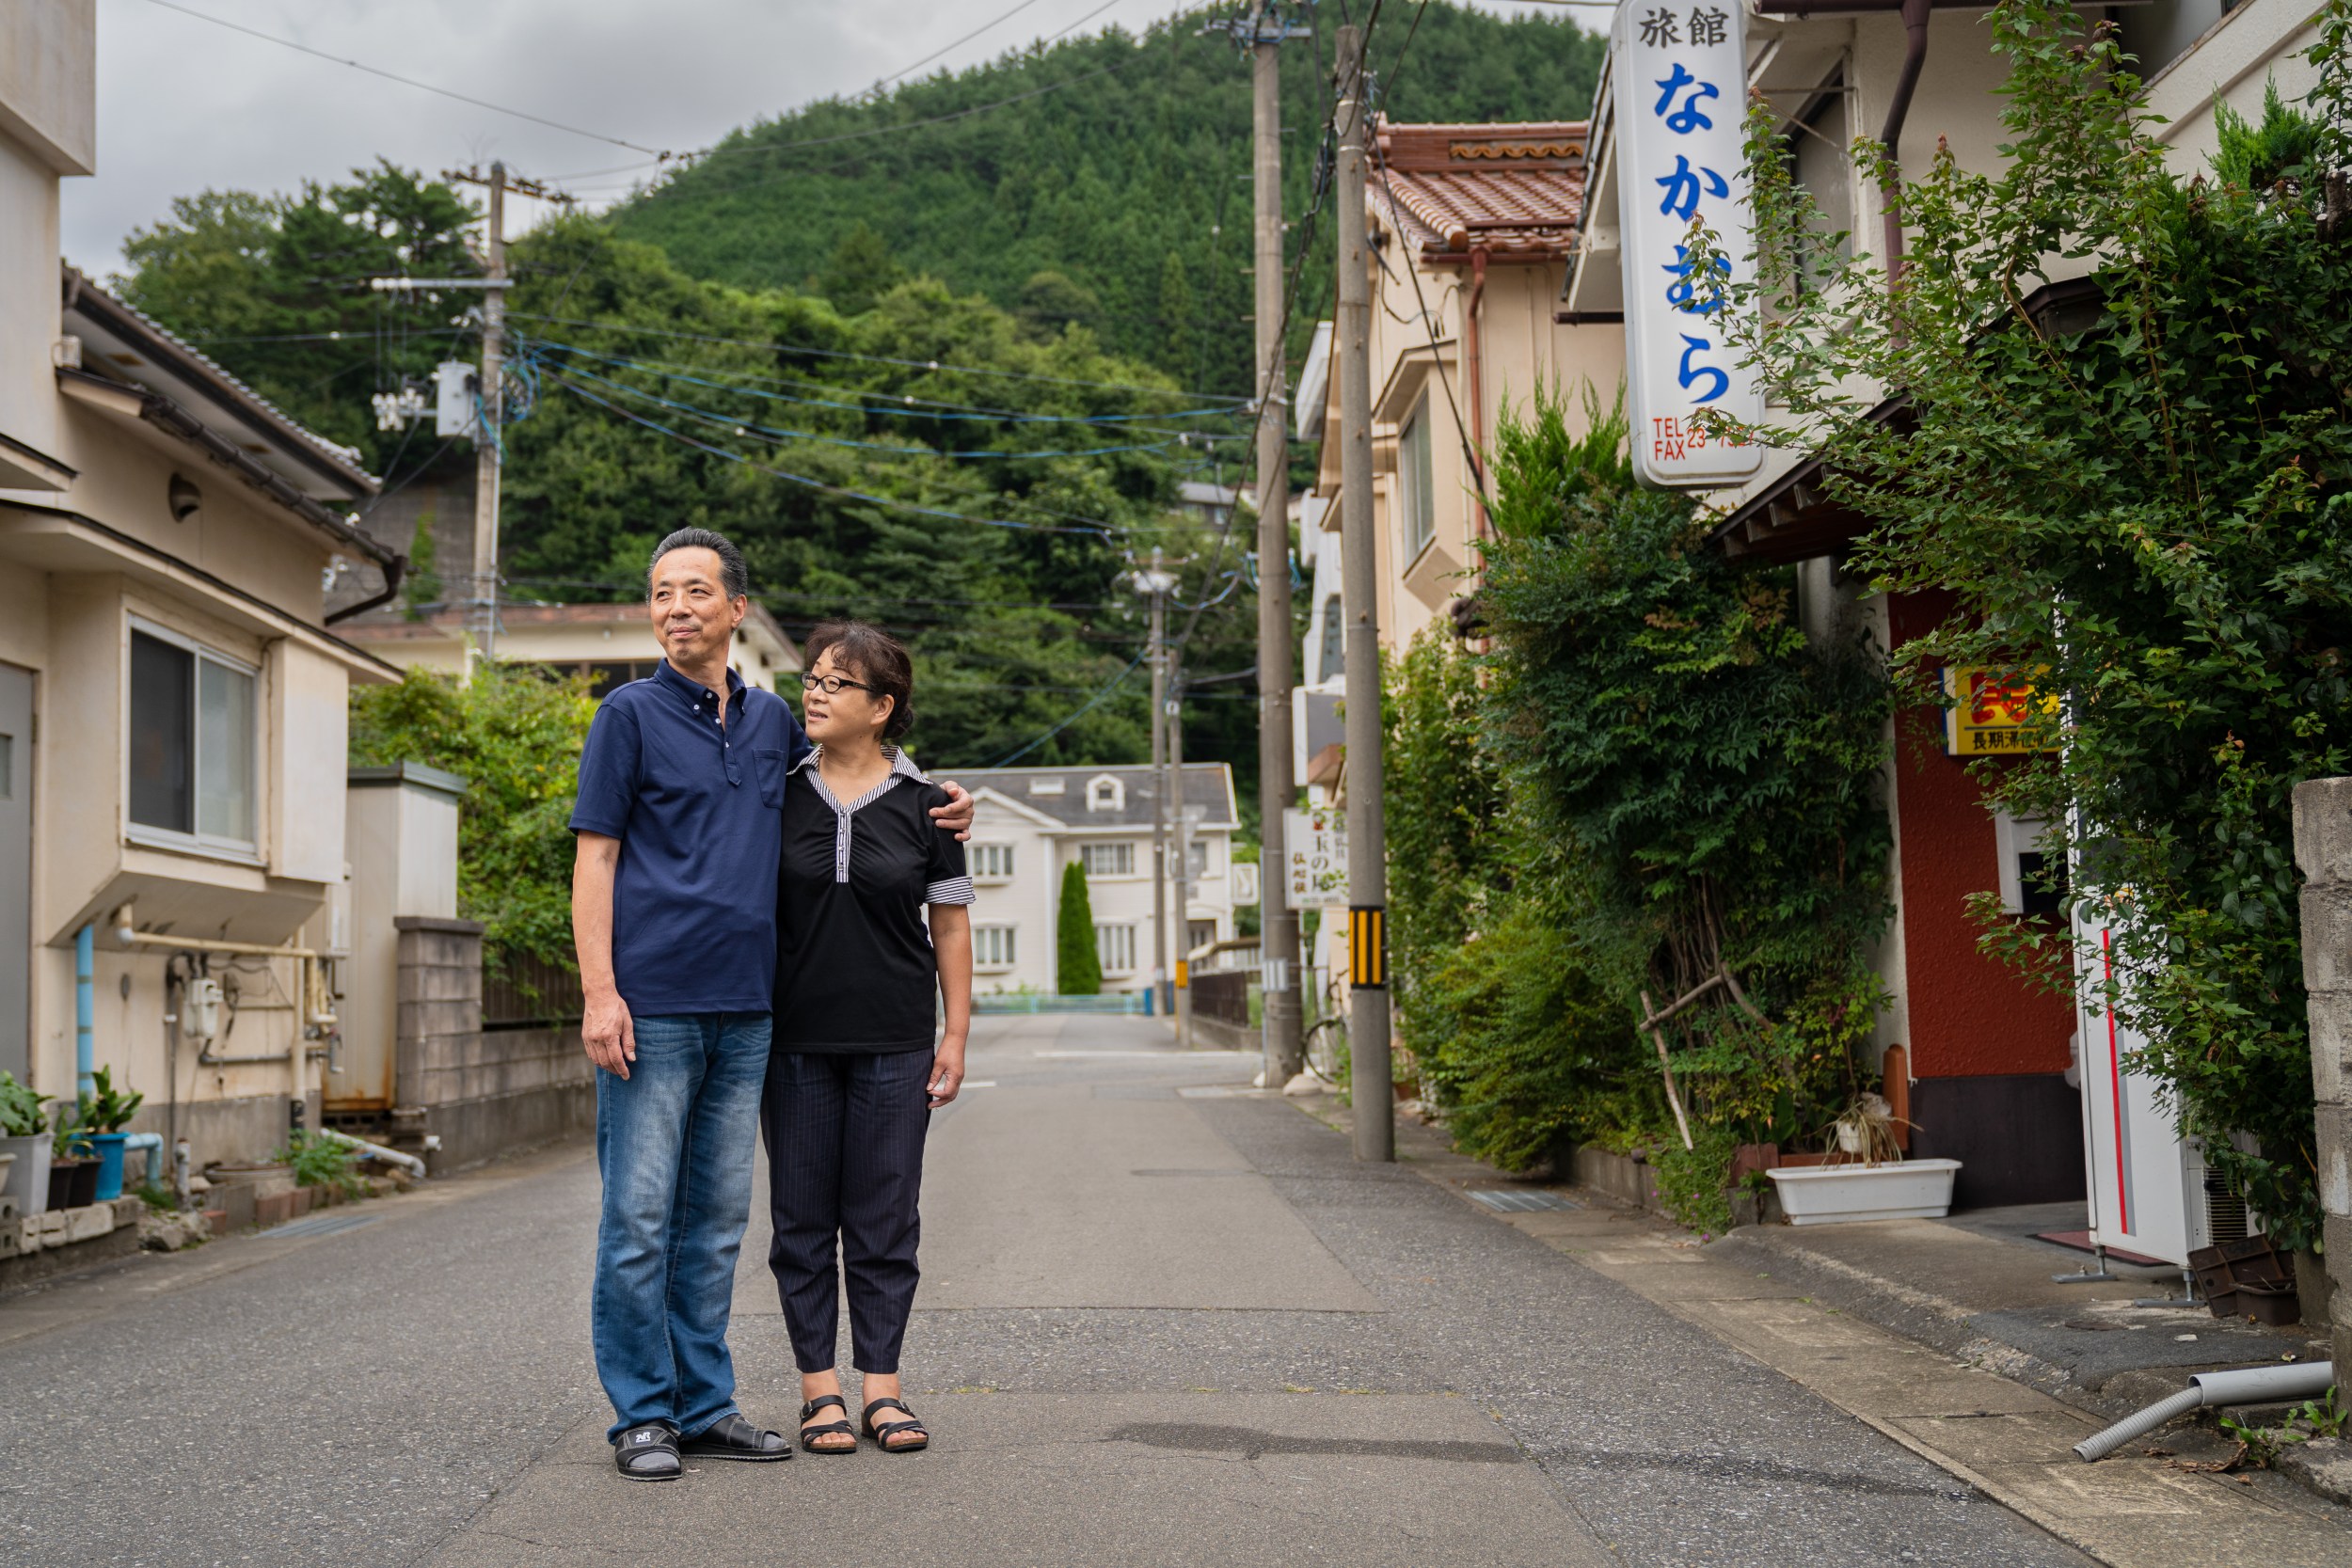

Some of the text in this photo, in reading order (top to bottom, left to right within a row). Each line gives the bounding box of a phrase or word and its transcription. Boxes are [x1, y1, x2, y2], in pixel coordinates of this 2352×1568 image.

[1639, 7, 1729, 49] 旅館
[1656, 62, 1732, 404] なかむら
[1652, 417, 1684, 438] TEL
[1654, 439, 1686, 461] FAX
